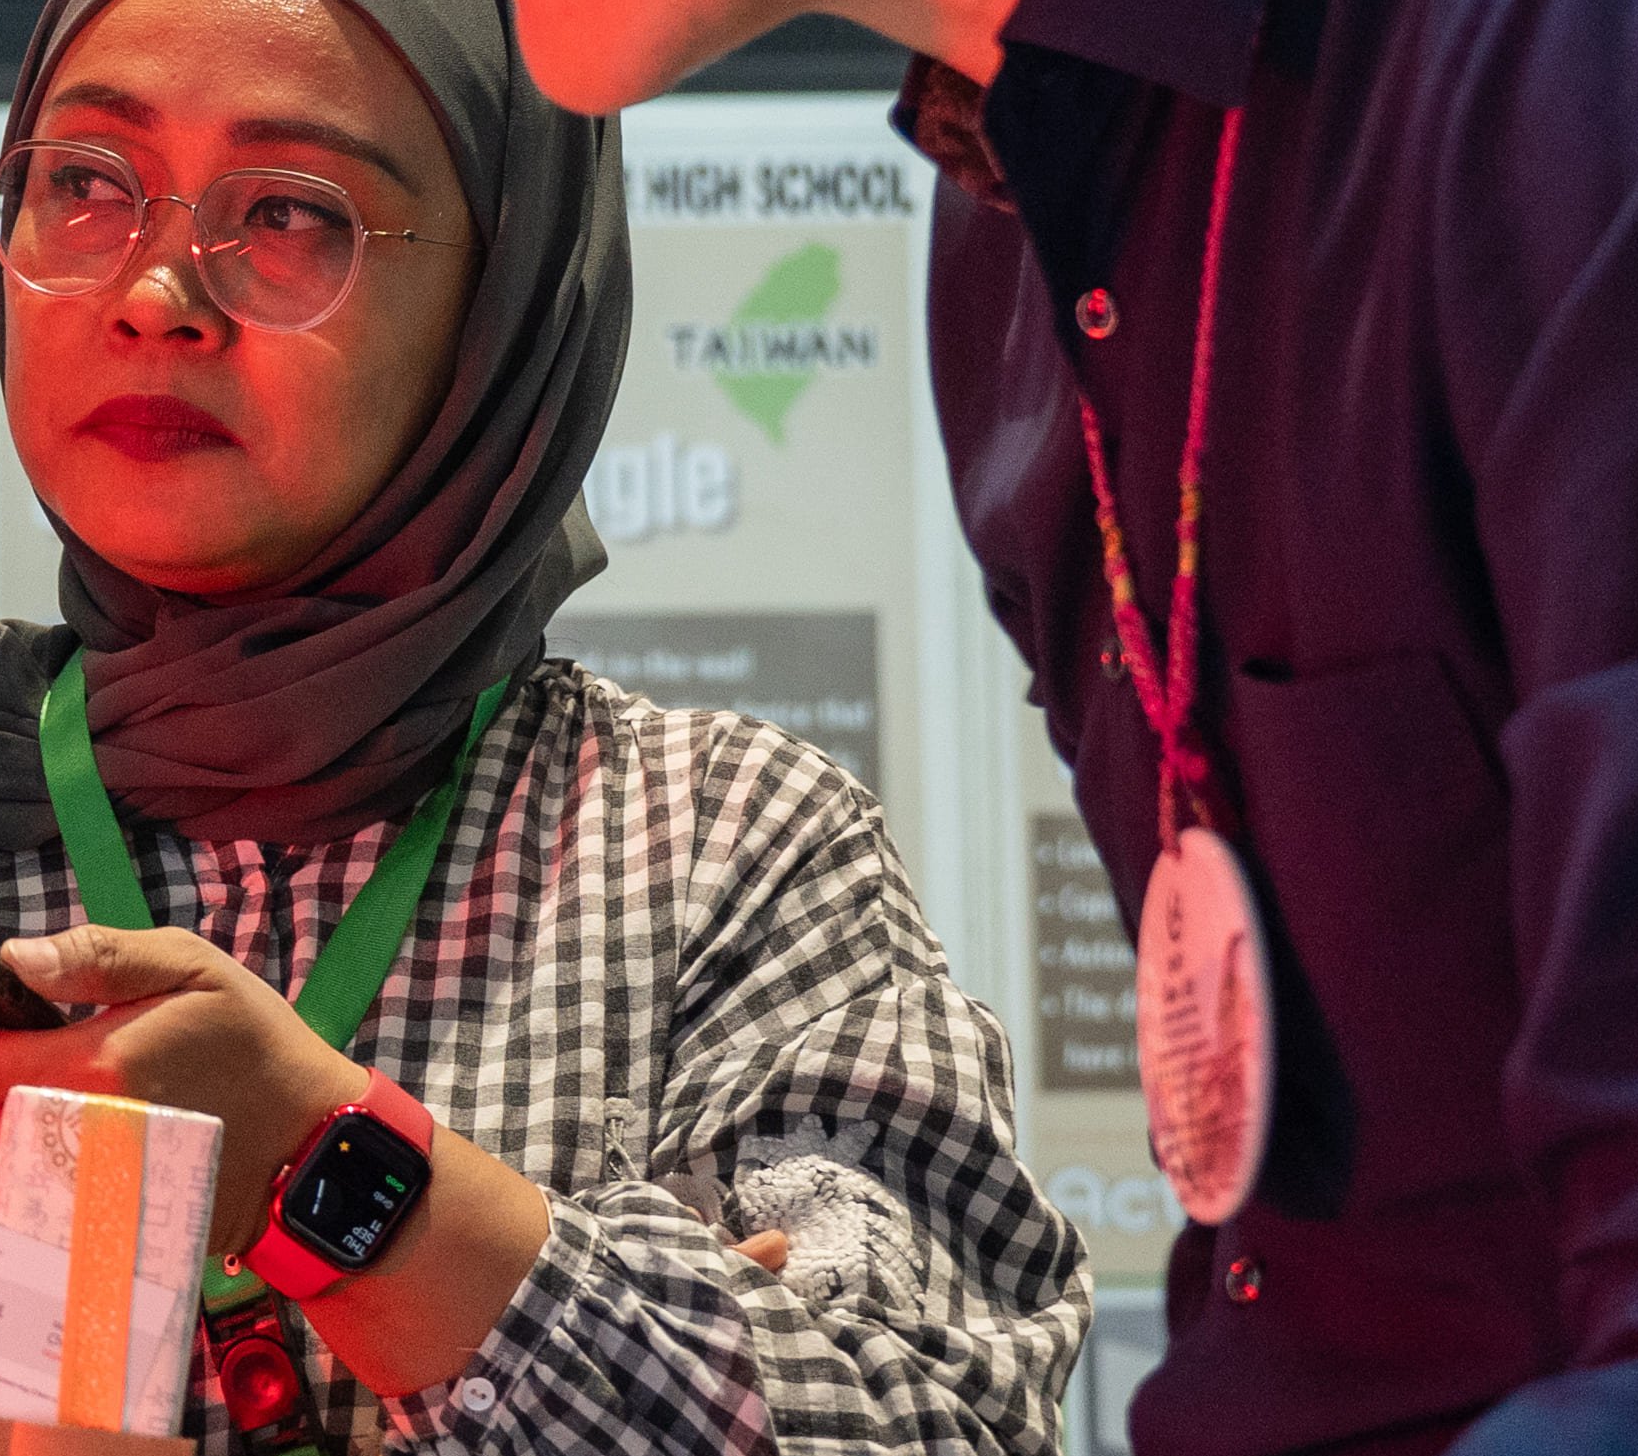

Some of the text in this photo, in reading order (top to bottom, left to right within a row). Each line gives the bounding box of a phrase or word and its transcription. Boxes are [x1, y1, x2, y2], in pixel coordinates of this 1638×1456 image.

[646, 159, 741, 214] HIGH
[758, 161, 917, 215] SCHOOL
[669, 322, 878, 368] TAIWAN
[352, 1226, 376, 1244] SEP
[368, 1219, 382, 1233] 11
[342, 1235, 366, 1256] THU
